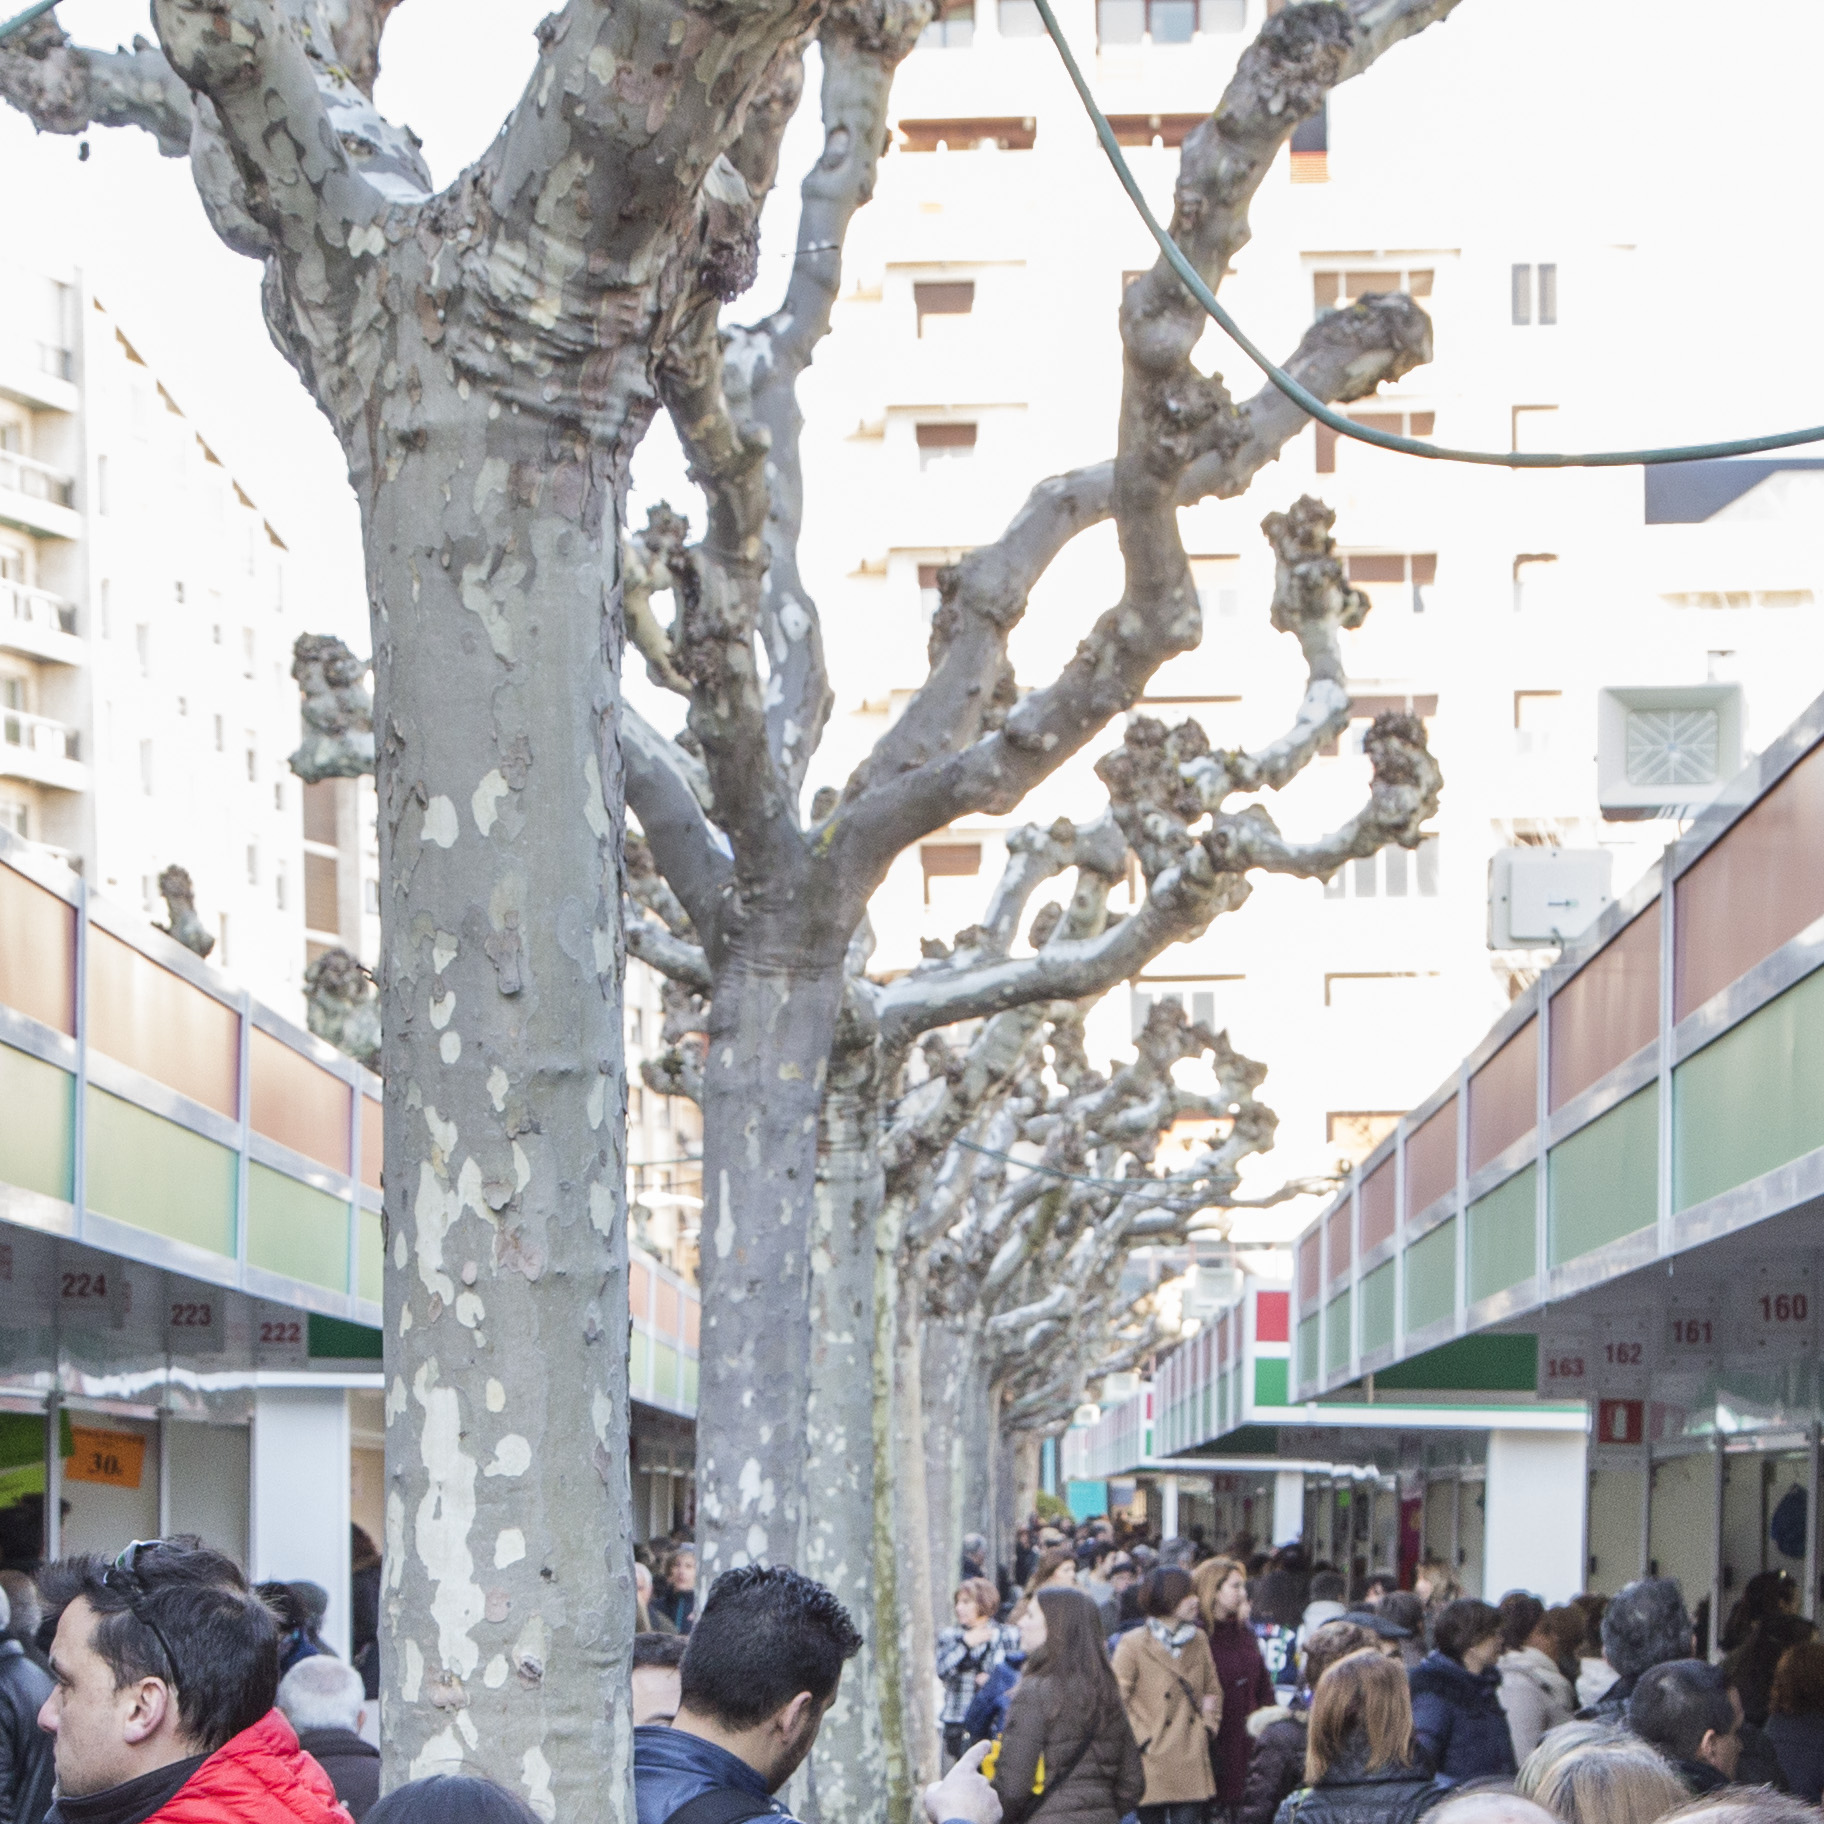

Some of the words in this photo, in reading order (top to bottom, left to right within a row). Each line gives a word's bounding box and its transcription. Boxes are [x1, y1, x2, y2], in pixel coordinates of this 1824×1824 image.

[61, 1272, 108, 1299] 224
[171, 1303, 212, 1327] 223
[1758, 1292, 1809, 1323] 160
[260, 1322, 301, 1344] 222
[1673, 1318, 1714, 1345] 161
[1606, 1341, 1643, 1366] 162
[1547, 1356, 1586, 1379] 163
